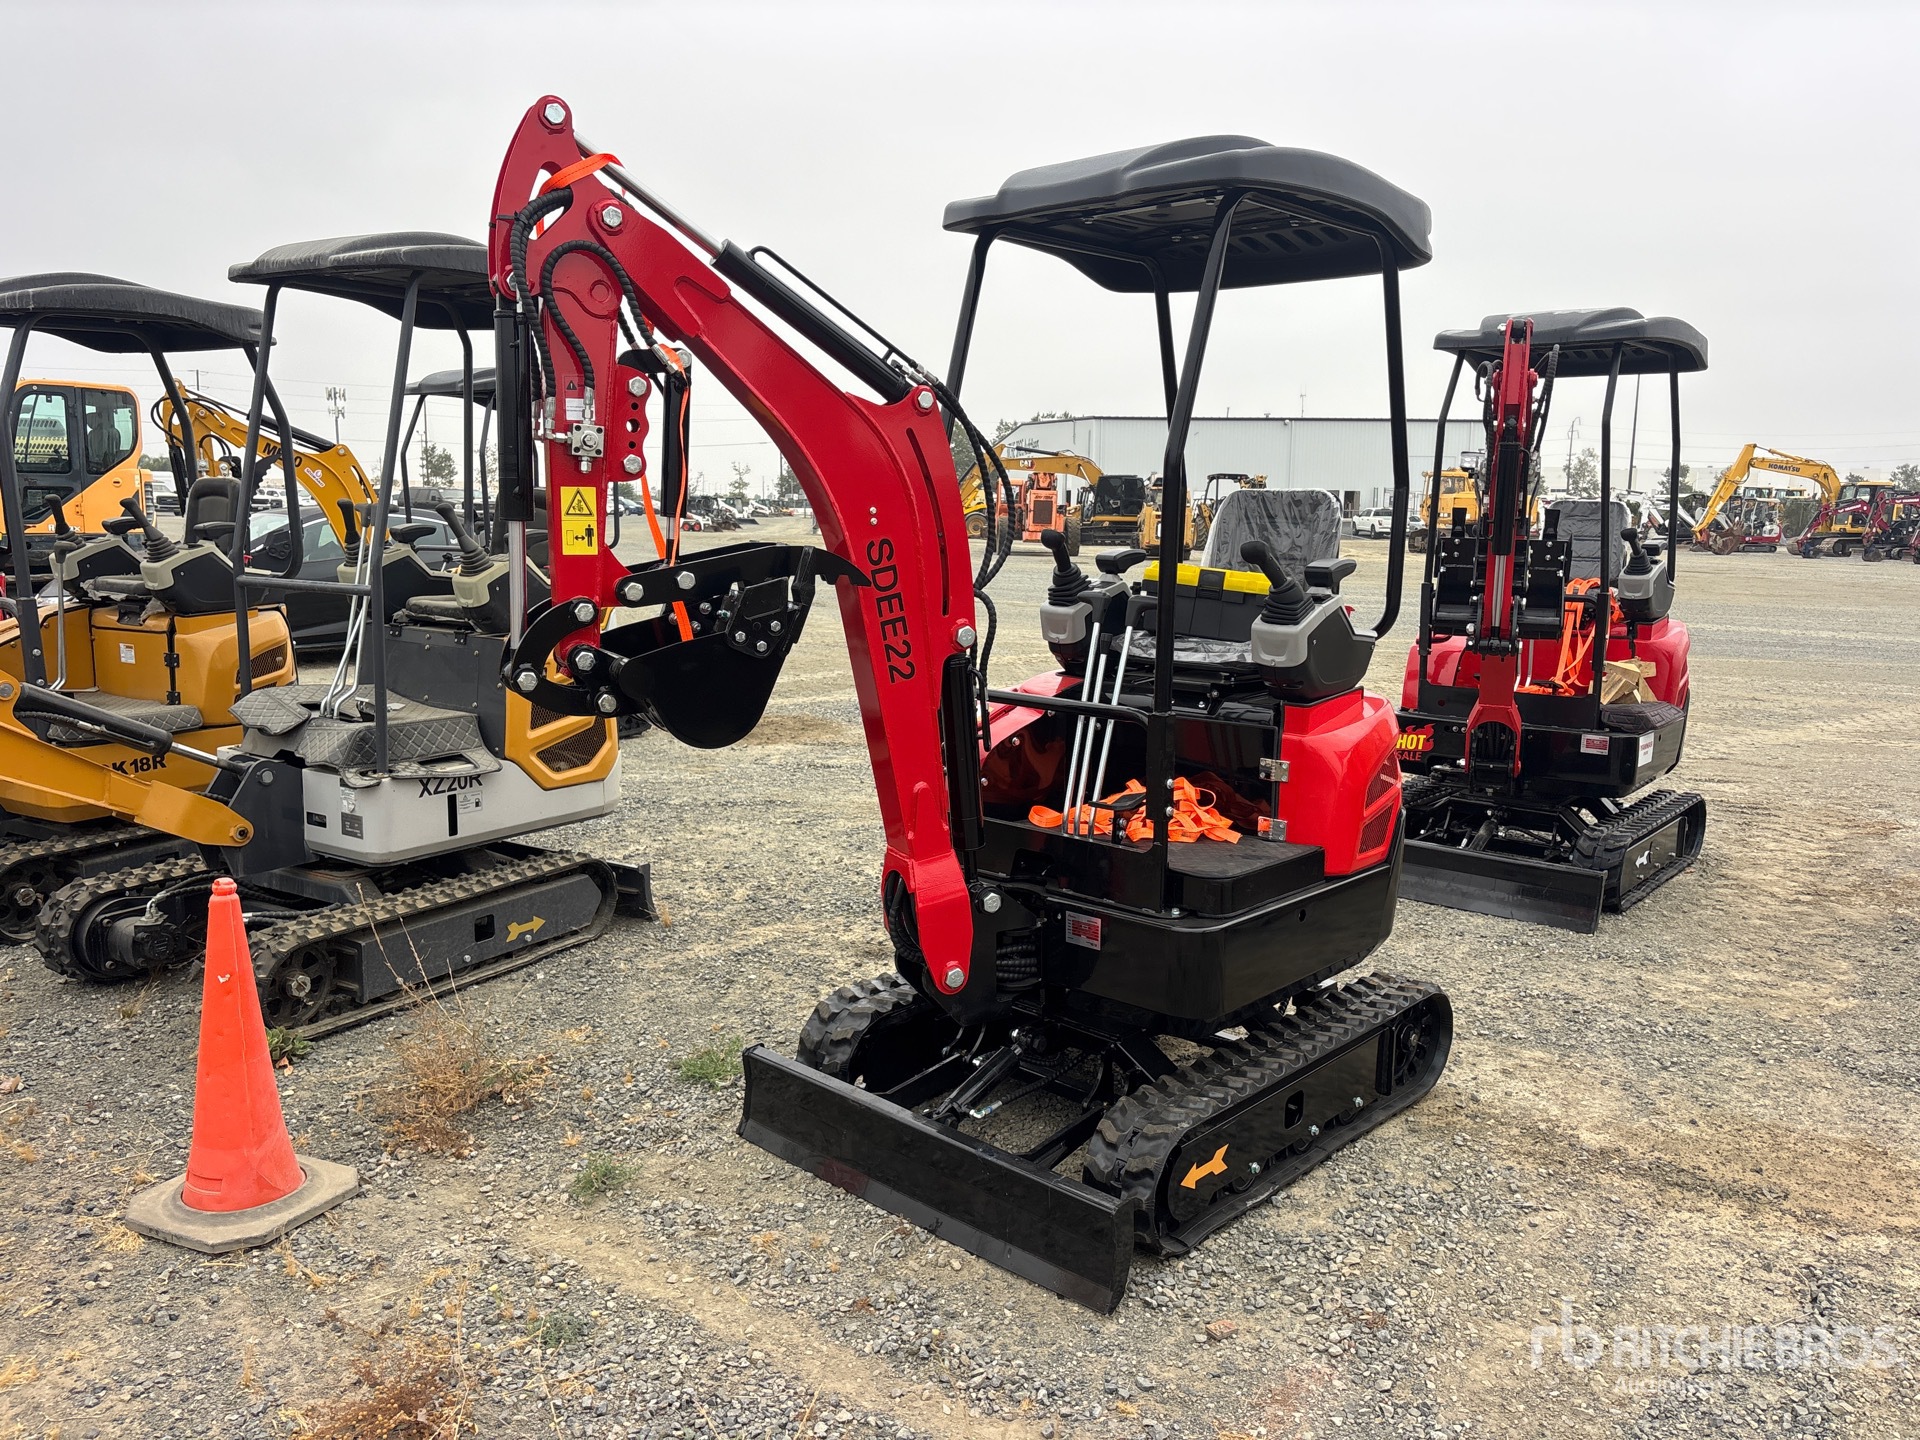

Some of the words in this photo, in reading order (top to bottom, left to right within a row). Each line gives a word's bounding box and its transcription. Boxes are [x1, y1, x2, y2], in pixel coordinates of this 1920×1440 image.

[1768, 463, 1801, 472] KOMATSU
[867, 538, 916, 684] SDEE22
[1396, 734, 1426, 750] HOT
[1396, 751, 1422, 761] SALE
[418, 774, 483, 798] XZ20R
